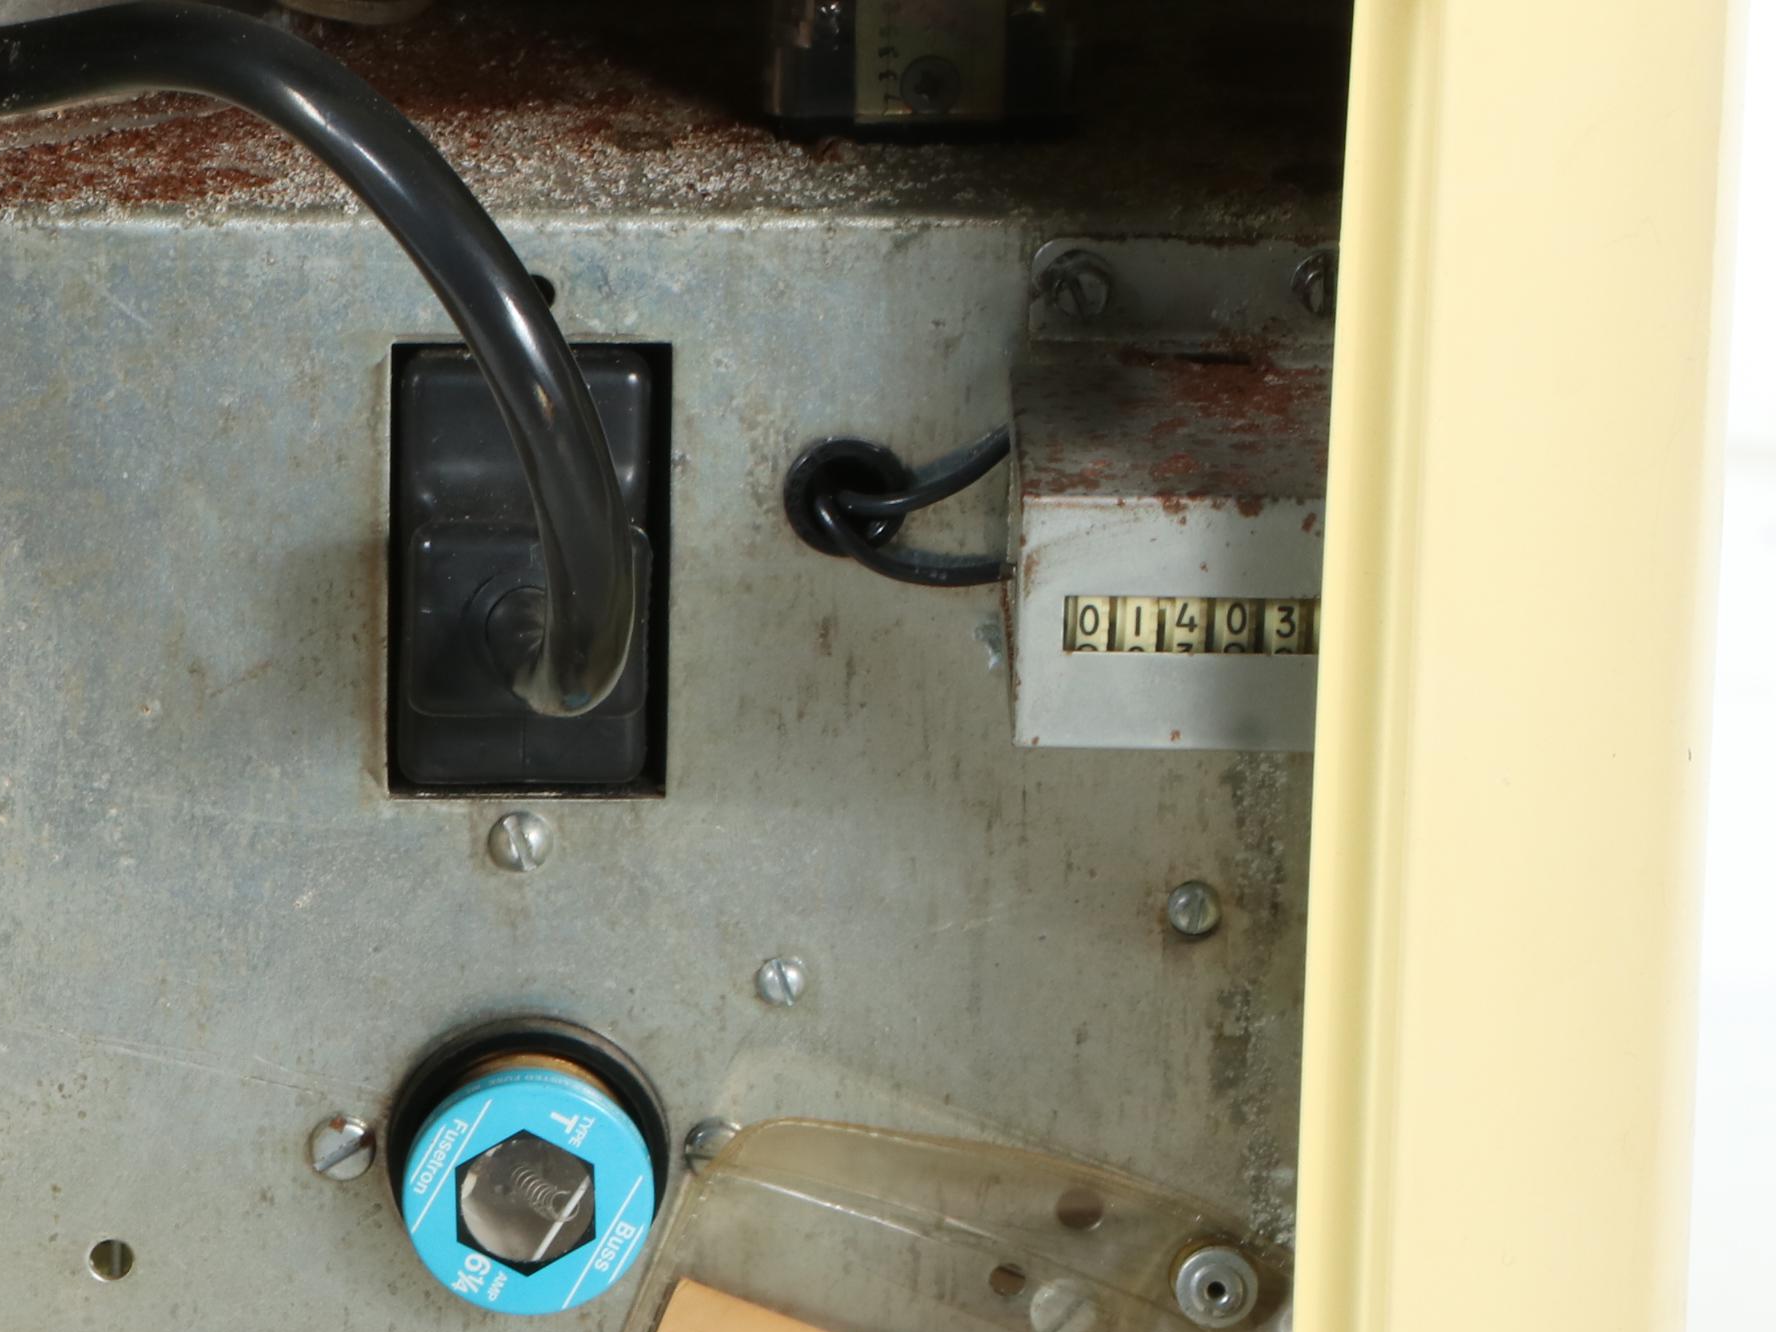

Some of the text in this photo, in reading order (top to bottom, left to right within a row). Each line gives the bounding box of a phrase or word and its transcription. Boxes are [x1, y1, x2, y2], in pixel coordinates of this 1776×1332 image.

[550, 1111, 580, 1135] T
[567, 1115, 597, 1148] TYPE
[413, 1117, 469, 1195] Fusetron
[594, 1221, 637, 1273] Buss
[487, 1271, 509, 1302] AMP
